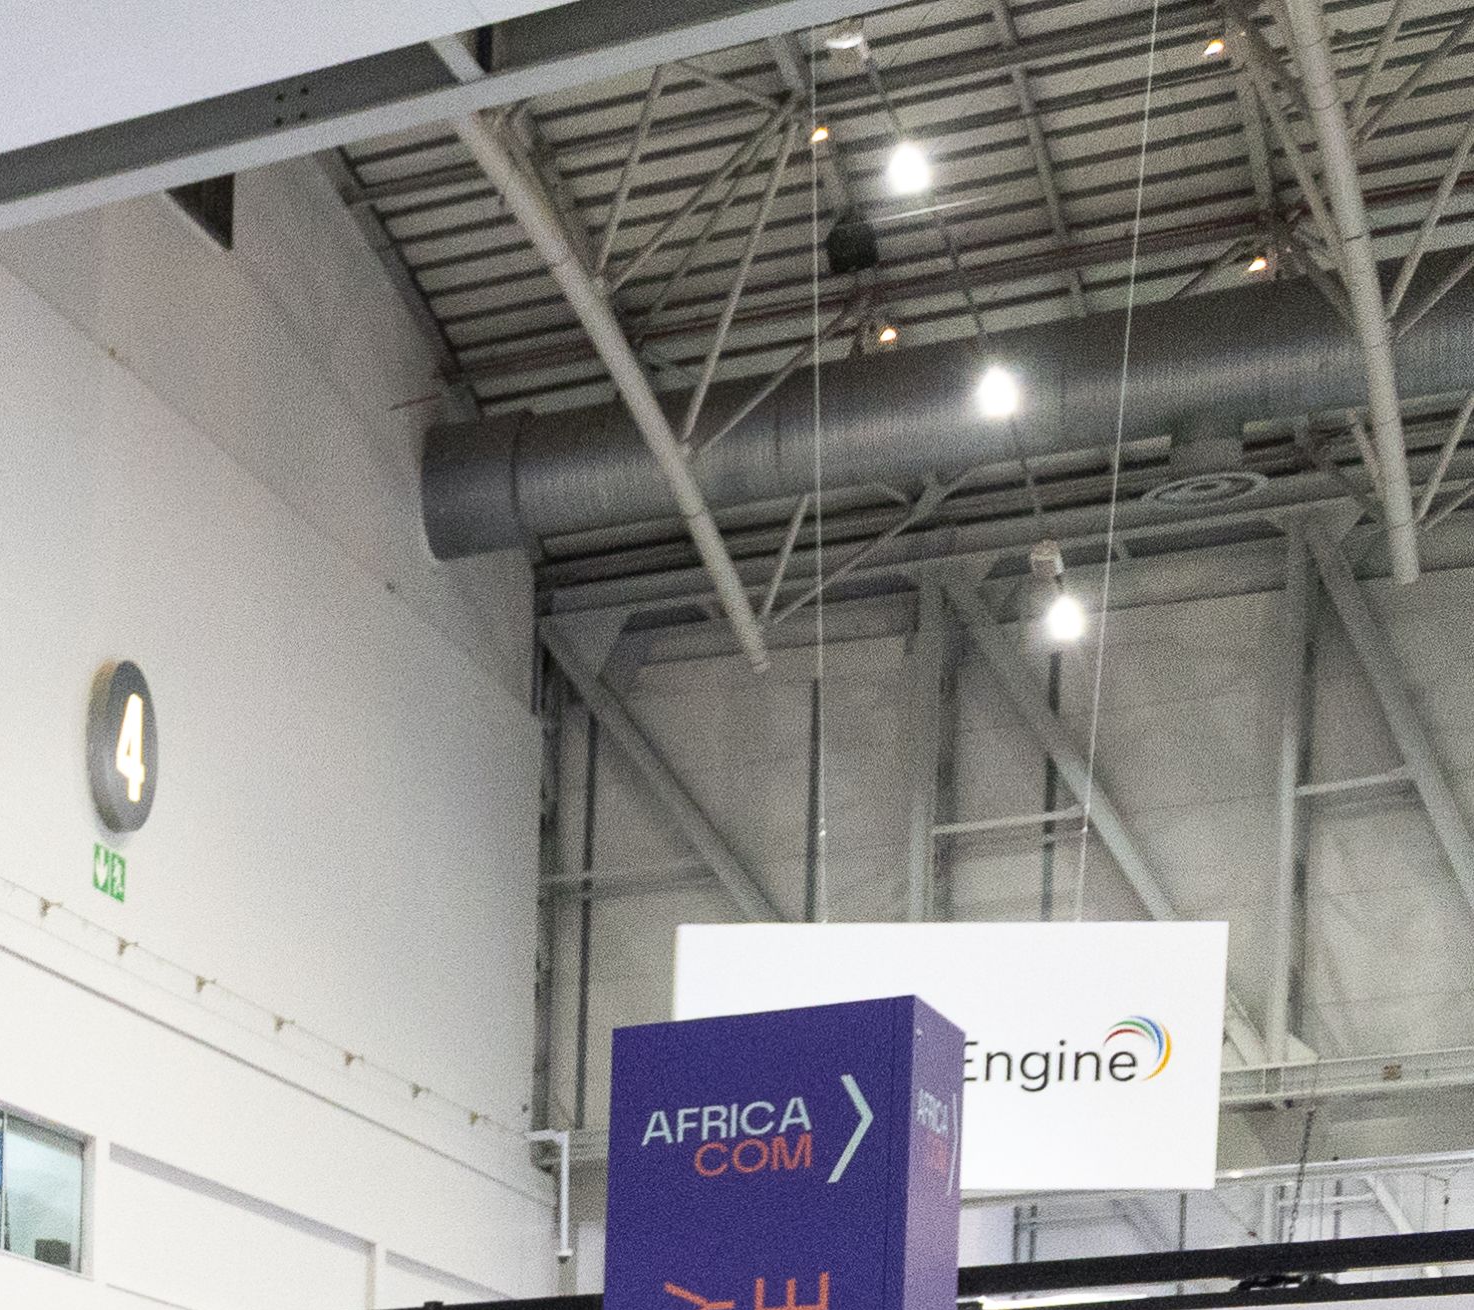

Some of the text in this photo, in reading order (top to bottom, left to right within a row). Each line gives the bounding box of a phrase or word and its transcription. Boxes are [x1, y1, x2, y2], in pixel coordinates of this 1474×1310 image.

[116, 693, 145, 803] 4
[641, 1098, 813, 1147] AFRICA
[694, 1135, 813, 1177] COM
